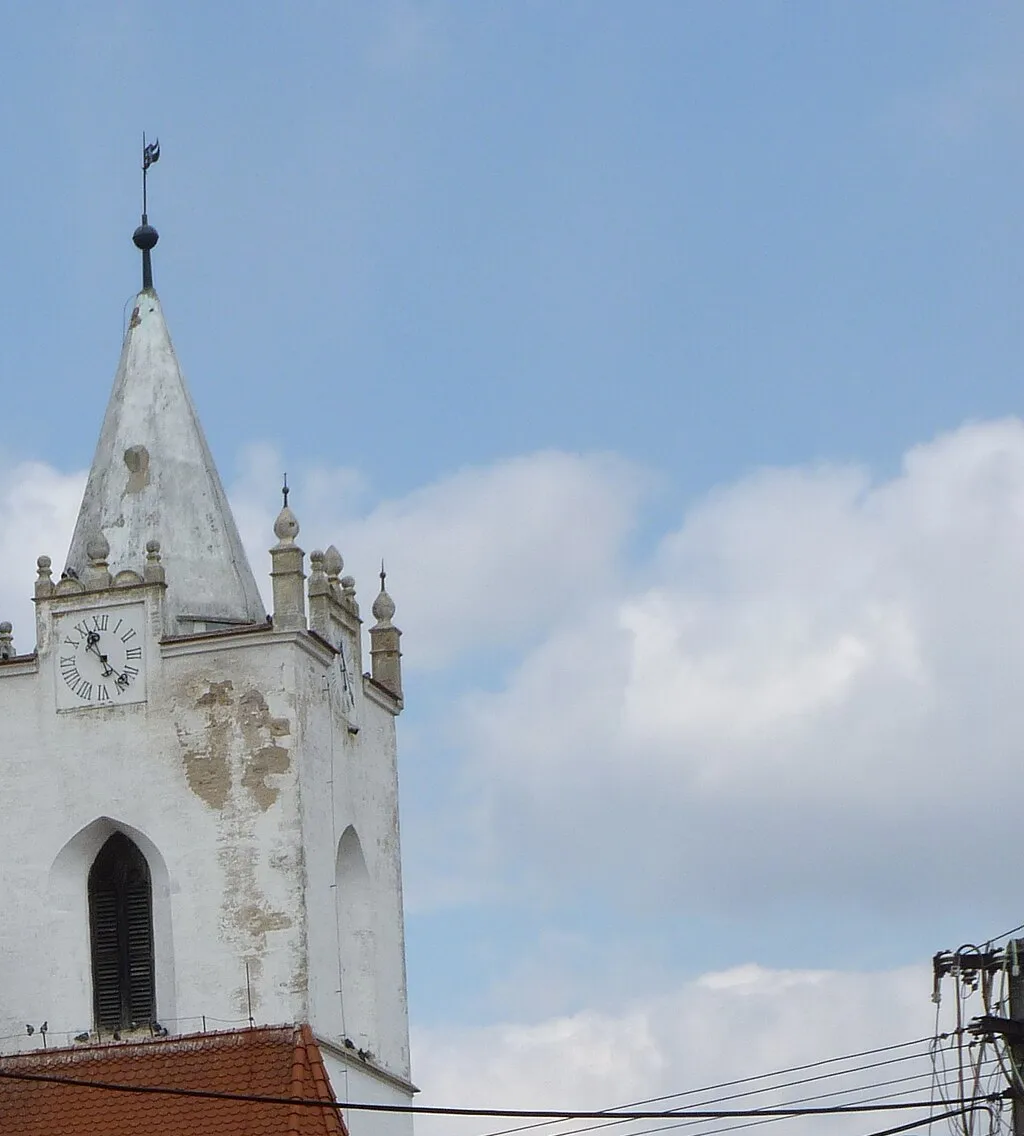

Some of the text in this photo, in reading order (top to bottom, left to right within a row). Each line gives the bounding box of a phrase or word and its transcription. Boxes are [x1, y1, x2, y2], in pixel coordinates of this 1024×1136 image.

[74, 619, 89, 639] XI
[93, 614, 108, 632] XII
[113, 619, 122, 634] I
[64, 635, 79, 650] X
[121, 628, 136, 643] II
[60, 655, 76, 667] IX
[126, 647, 142, 660] III
[62, 668, 82, 691] VIII
[76, 681, 93, 701] VII
[97, 684, 110, 701] VI
